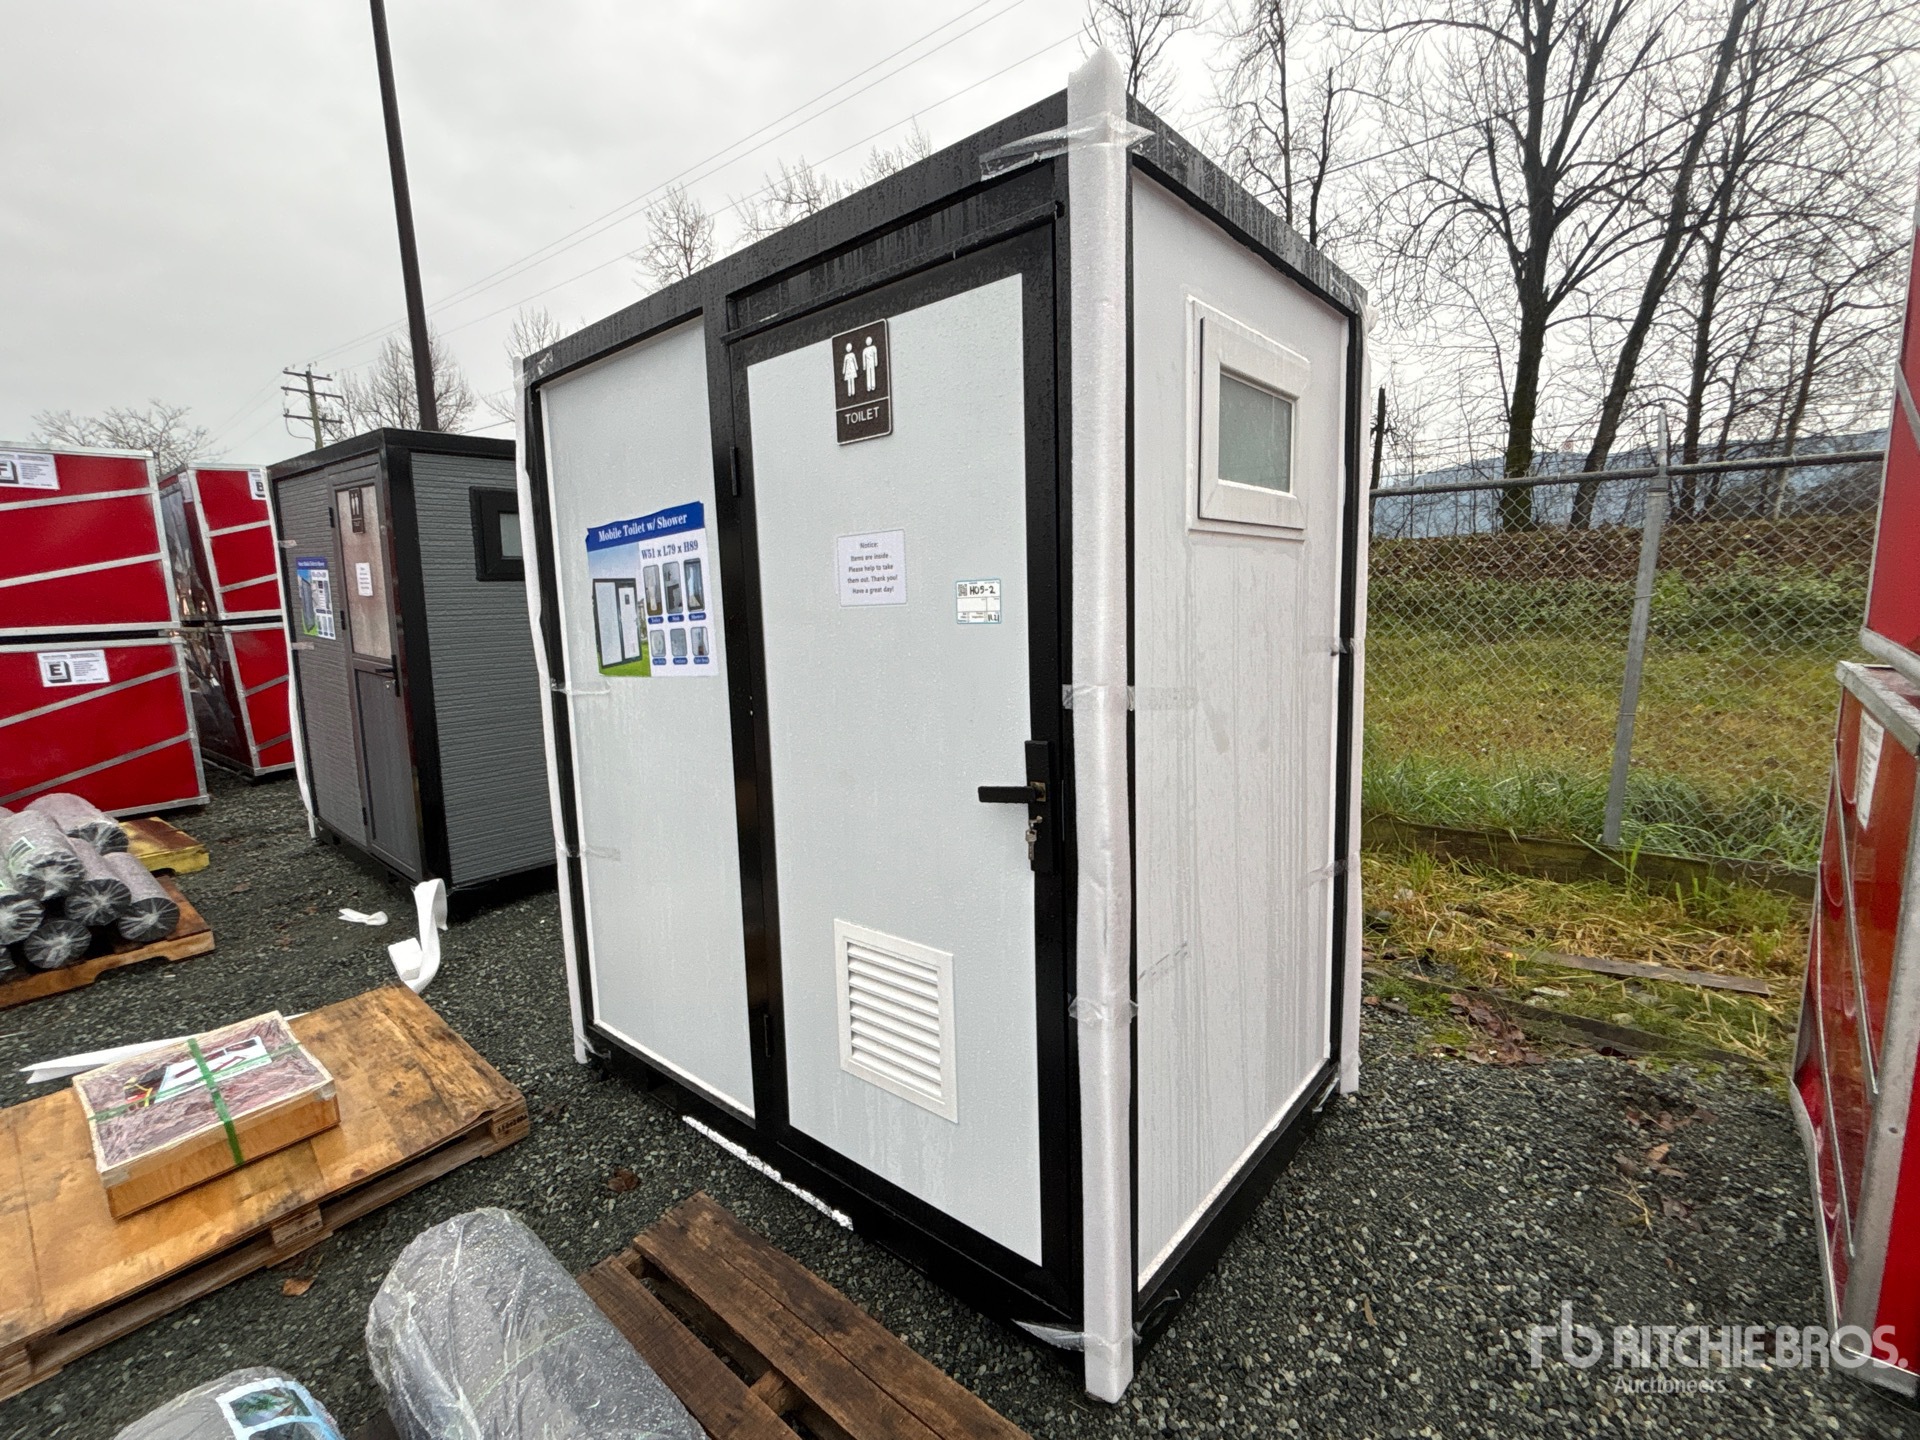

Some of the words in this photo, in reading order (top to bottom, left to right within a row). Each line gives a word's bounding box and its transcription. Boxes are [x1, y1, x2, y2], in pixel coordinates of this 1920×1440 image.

[844, 406, 880, 425] TOILET
[598, 527, 622, 542] Mobile
[623, 522, 645, 537] Toilet
[646, 518, 656, 531] w/
[657, 514, 688, 529] Shower
[641, 549, 656, 560] W51
[662, 544, 676, 557] L79
[677, 546, 682, 554] x
[683, 540, 699, 552] H89
[864, 564, 875, 573] help
[882, 563, 893, 571] take
[871, 575, 886, 583] Thank
[49, 663, 63, 676] E
